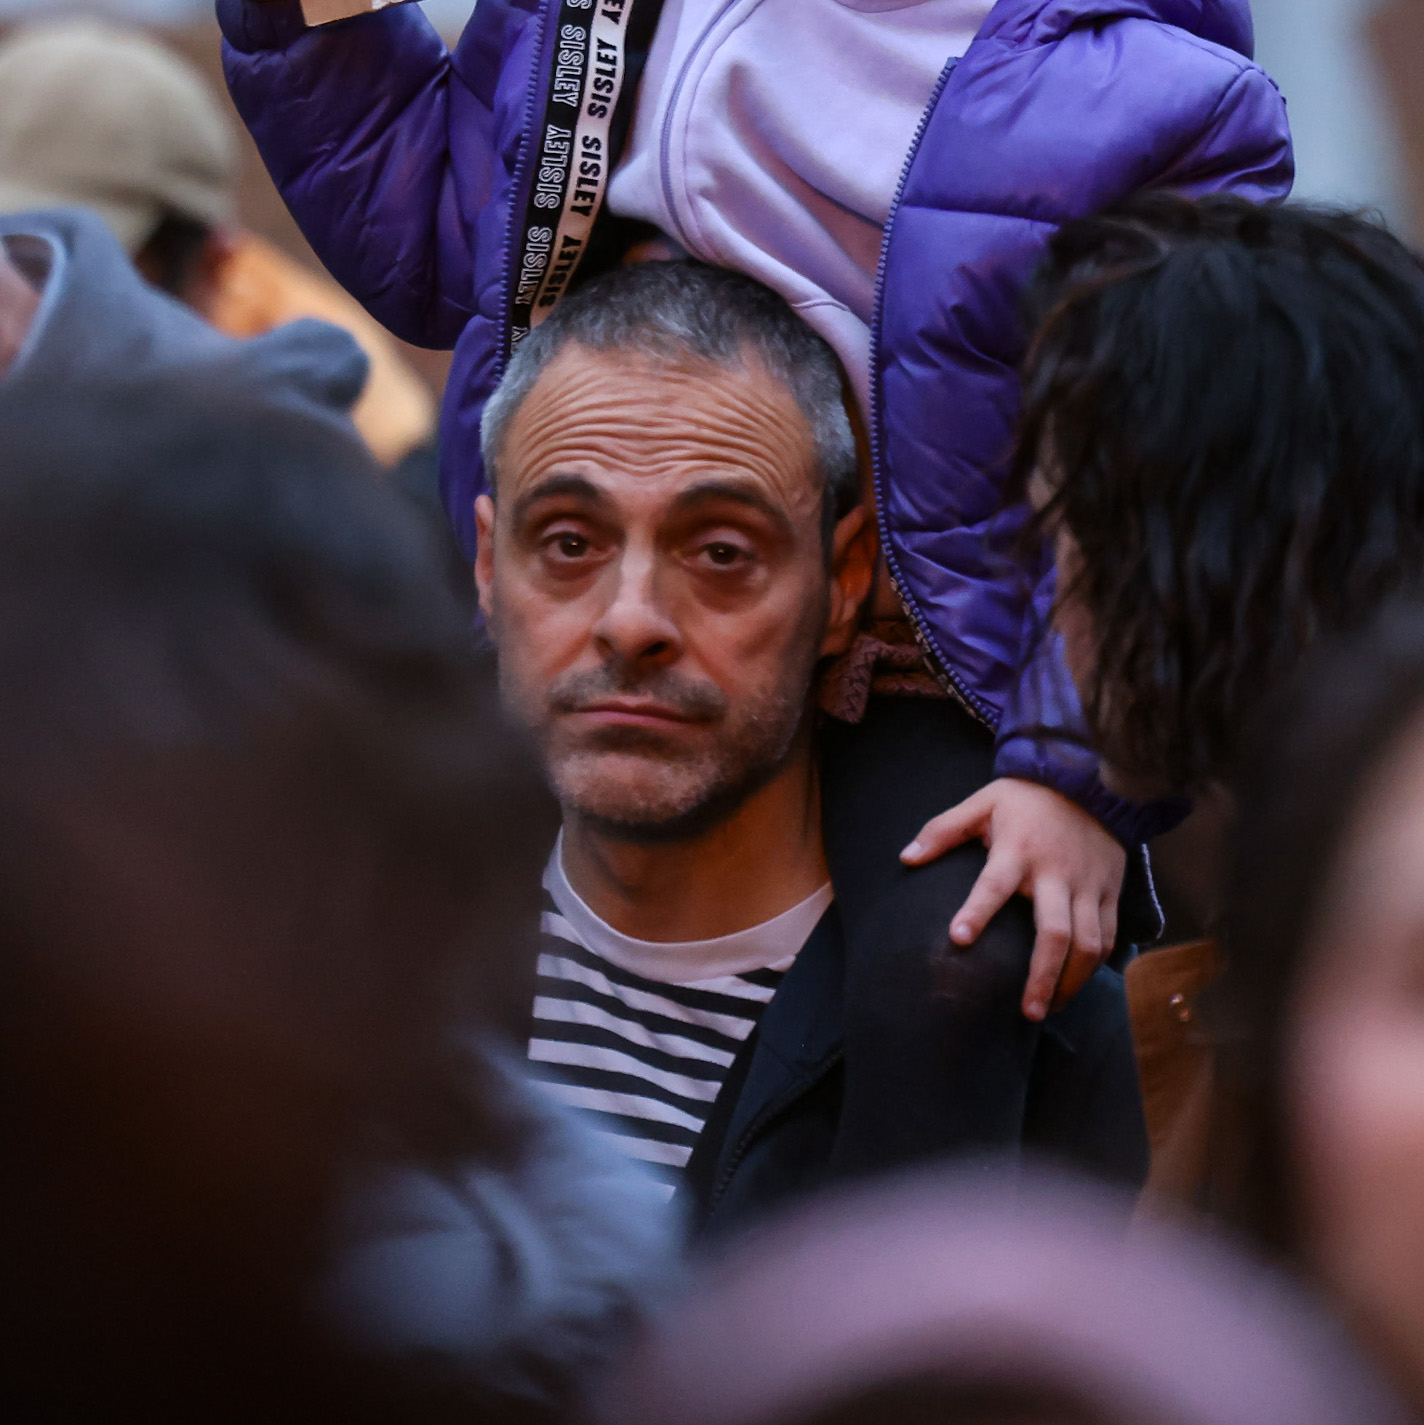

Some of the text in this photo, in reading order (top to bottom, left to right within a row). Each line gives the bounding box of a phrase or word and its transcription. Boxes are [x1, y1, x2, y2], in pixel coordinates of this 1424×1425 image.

[552, 25, 587, 108] SISLEY
[588, 37, 617, 118] SISLEY
[534, 124, 572, 209] SISLEY
[570, 135, 602, 217] SISLEY
[539, 235, 582, 307] SISLEY
